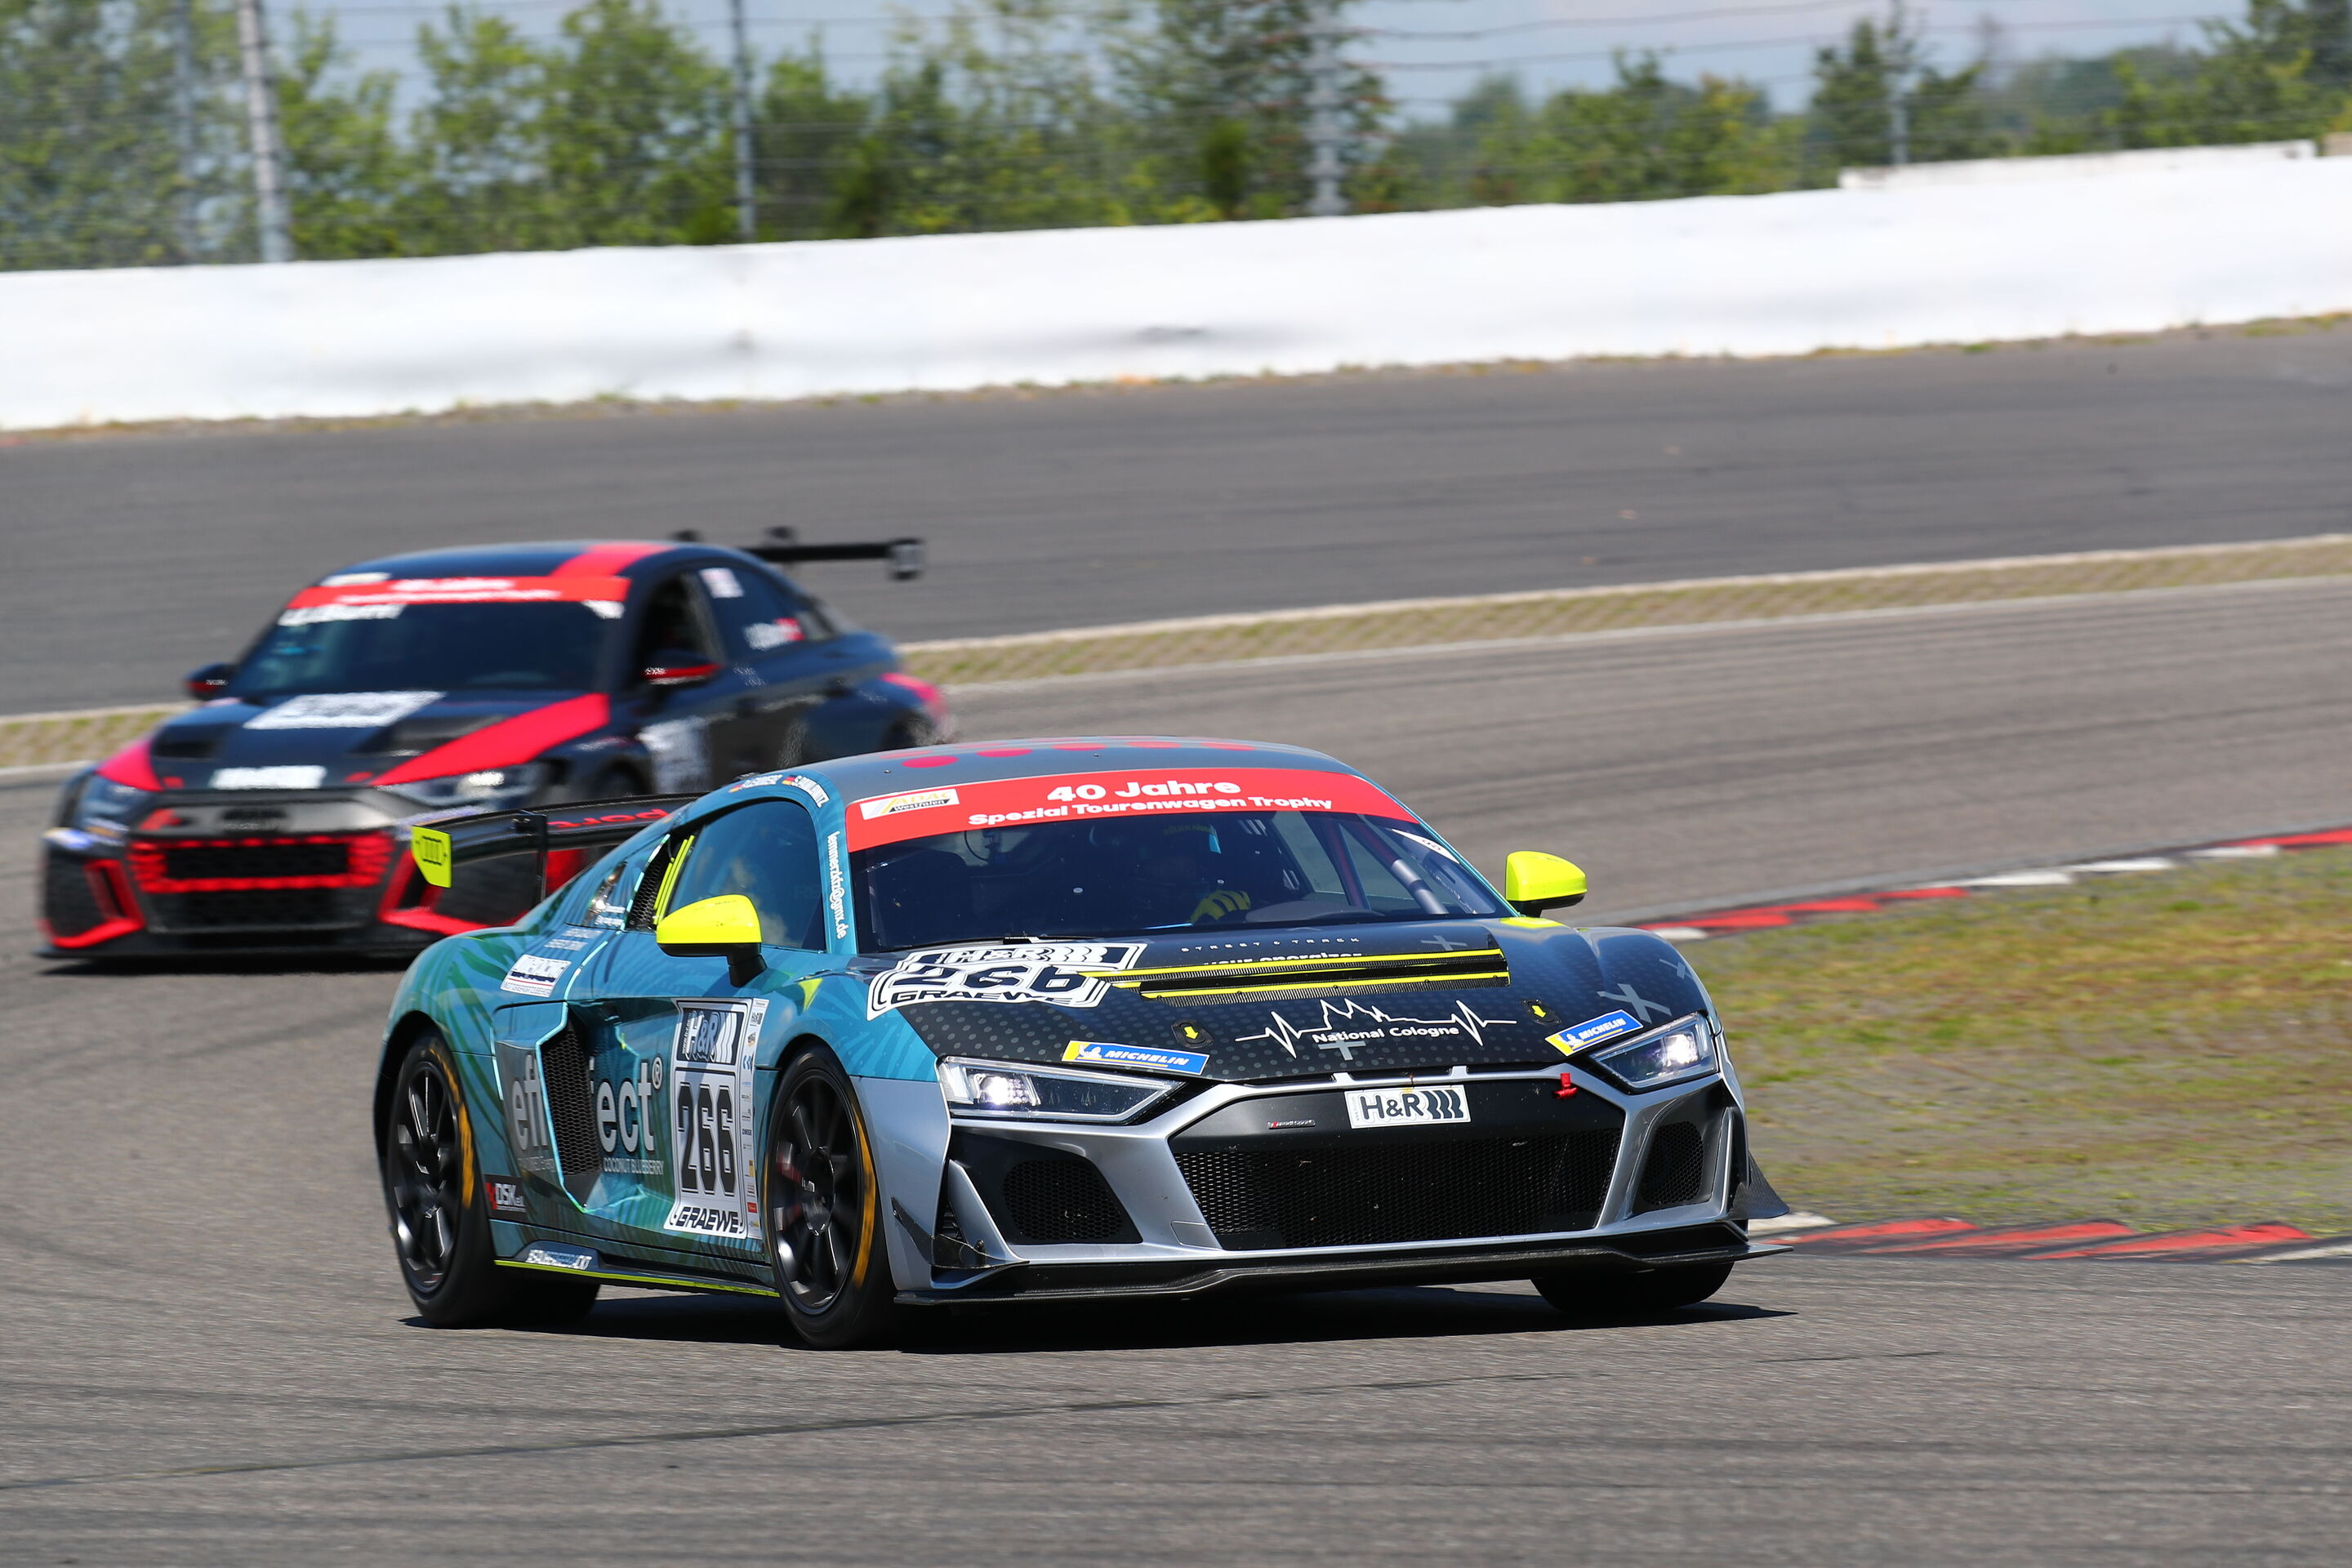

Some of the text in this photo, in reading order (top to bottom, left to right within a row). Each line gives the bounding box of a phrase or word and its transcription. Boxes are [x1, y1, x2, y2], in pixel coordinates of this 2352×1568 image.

[1047, 780, 1241, 801] 40 Jahre
[968, 796, 1332, 825] Spezial Tourenwagen Trophy
[889, 964, 1089, 993] 266
[684, 1010, 719, 1060] H&R
[1312, 1024, 1459, 1044] National Cologne
[1578, 1018, 1627, 1040] MICHELIN
[1104, 1049, 1189, 1066] MICHELIN
[1360, 1093, 1423, 1120] H&R
[677, 1082, 736, 1196] 266
[676, 1205, 740, 1234] GRAEWE
